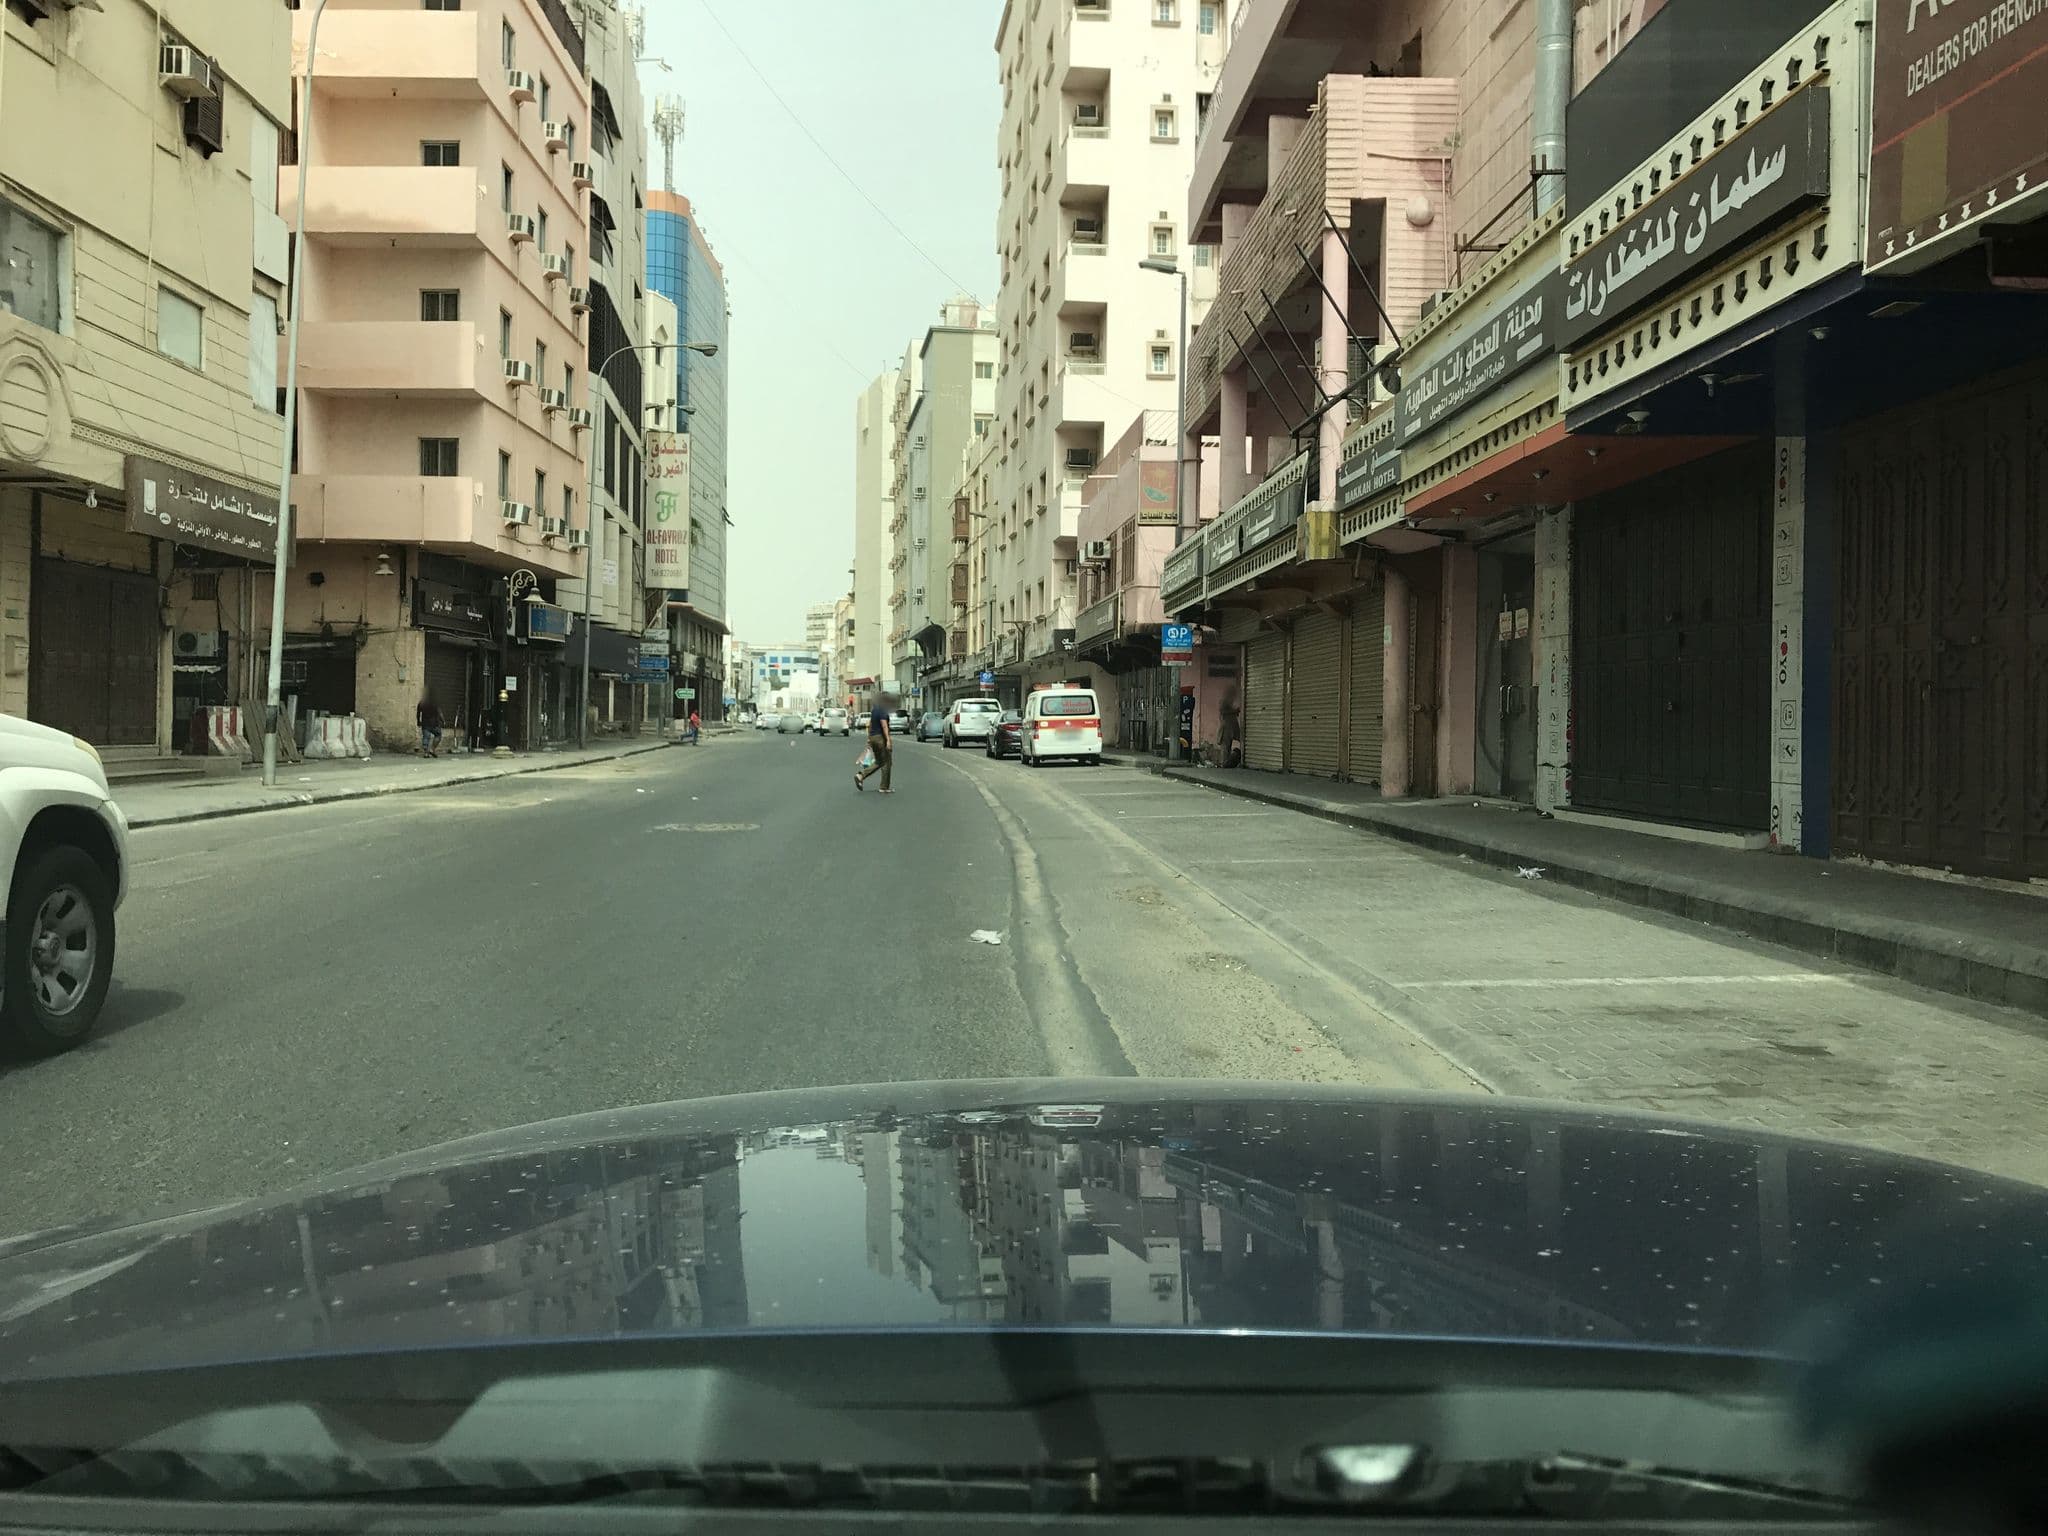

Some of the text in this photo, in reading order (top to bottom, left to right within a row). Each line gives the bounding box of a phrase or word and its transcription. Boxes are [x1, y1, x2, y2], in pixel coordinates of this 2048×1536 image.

[1907, 34, 1960, 97] DEALERS
[1963, 15, 1988, 61] FOR
[1566, 144, 1786, 320] سلمان للنظارات
[1405, 295, 1543, 416] مدينة العطورات العالمية
[651, 439, 688, 458] فندق
[648, 459, 688, 479] الفيروز
[1344, 467, 1396, 504] MAKKAH HOTEL
[168, 478, 277, 527] مؤسسة الشامل للتجارة
[646, 529, 688, 544] AL-FAYROZ
[655, 549, 679, 564] HOTEL
[1179, 627, 1188, 639] P
